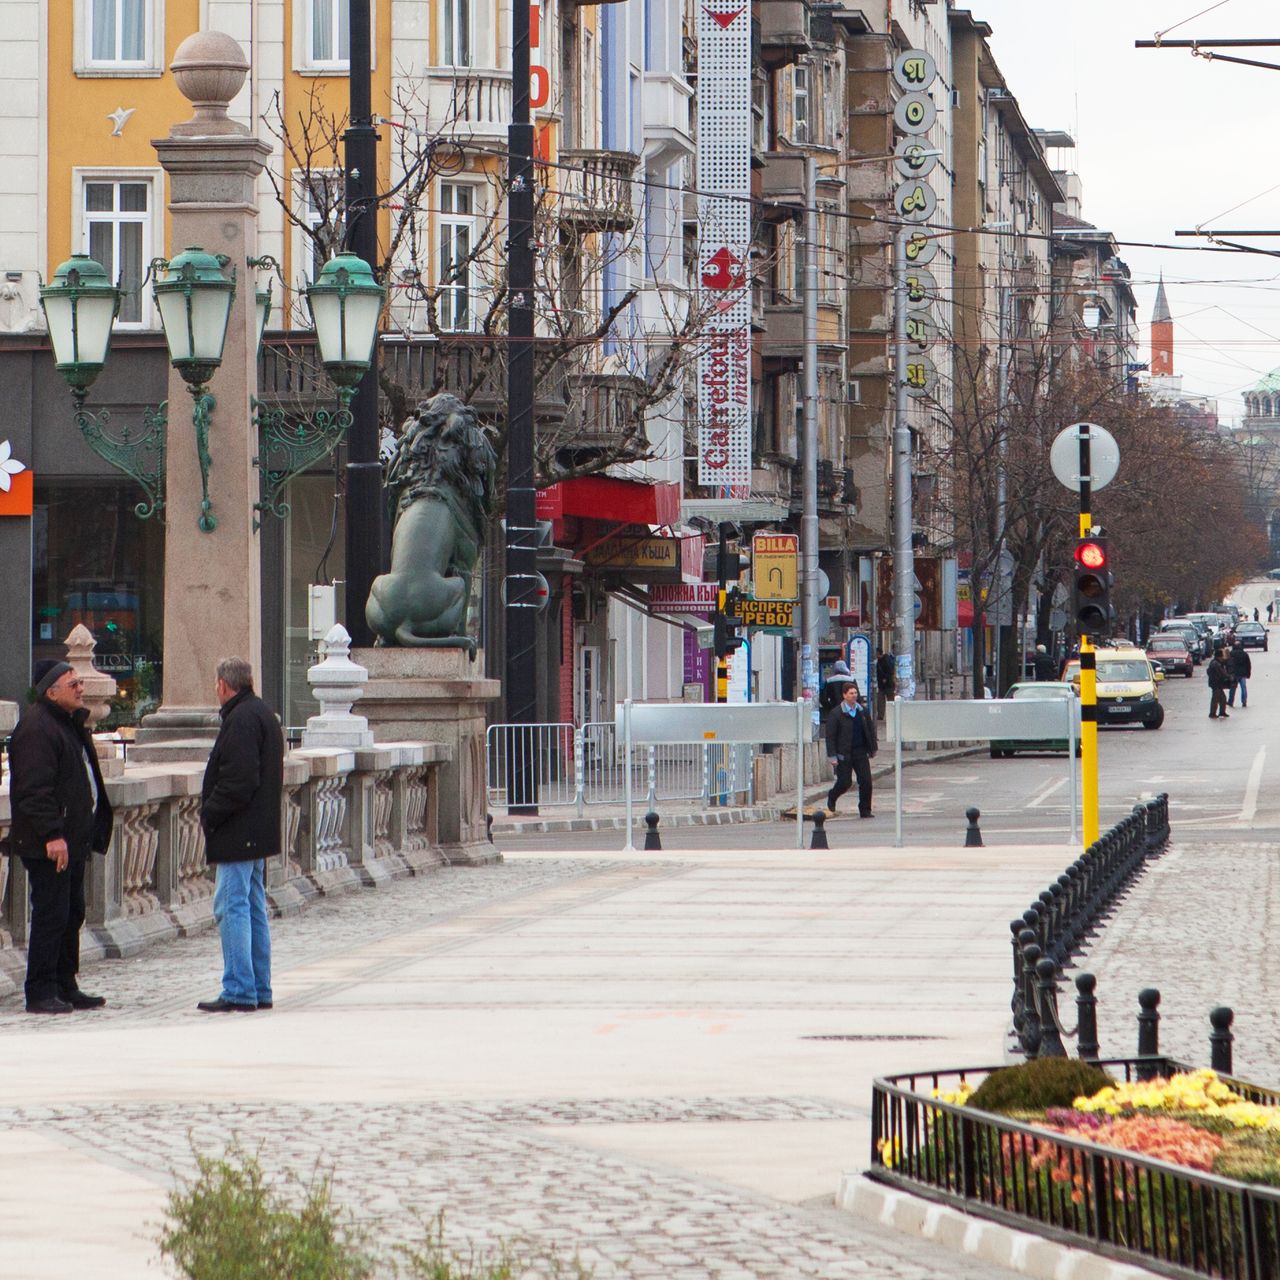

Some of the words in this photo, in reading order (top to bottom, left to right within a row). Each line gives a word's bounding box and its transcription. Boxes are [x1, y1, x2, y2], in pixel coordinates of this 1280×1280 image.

[703, 326, 730, 469] Carrefour
[641, 544, 670, 561] КЪЩА
[755, 538, 795, 552] BILLA
[650, 585, 695, 602] ЗАЛОЖНА
[734, 601, 800, 613] ЕКСПРЕС
